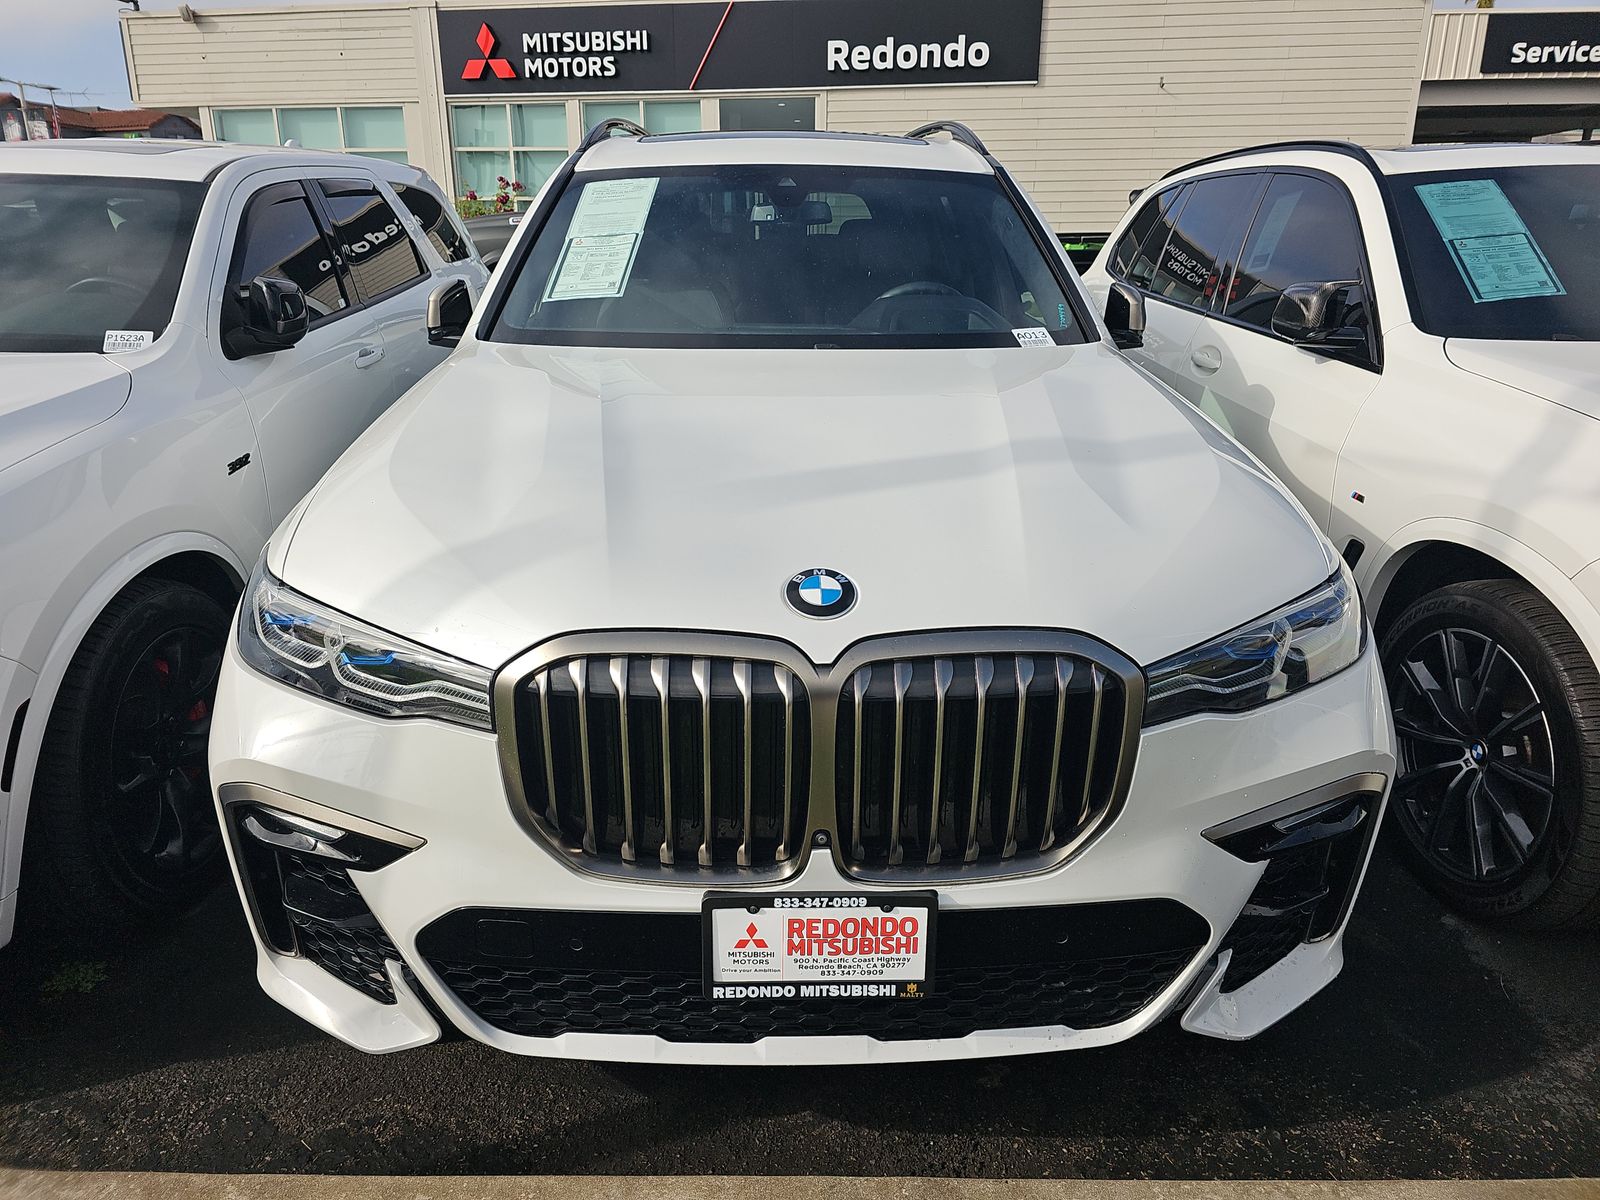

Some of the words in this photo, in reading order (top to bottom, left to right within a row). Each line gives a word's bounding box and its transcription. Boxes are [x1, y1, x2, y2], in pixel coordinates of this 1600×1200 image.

[522, 30, 648, 53] MITSUBISHI
[827, 34, 990, 71] Redondo
[1510, 40, 1600, 63] Service
[524, 56, 616, 78] MOTORS
[106, 334, 145, 342] P1523A
[792, 569, 849, 584] BMW
[773, 897, 868, 908] 833-347-0909
[787, 916, 919, 938] REDONDO
[786, 936, 919, 956] MITSUBISHI
[876, 956, 912, 965] Highway
[820, 969, 884, 977] 833-347-0909
[712, 985, 796, 998] REDONDO
[800, 984, 897, 998] MITSUBISHI
